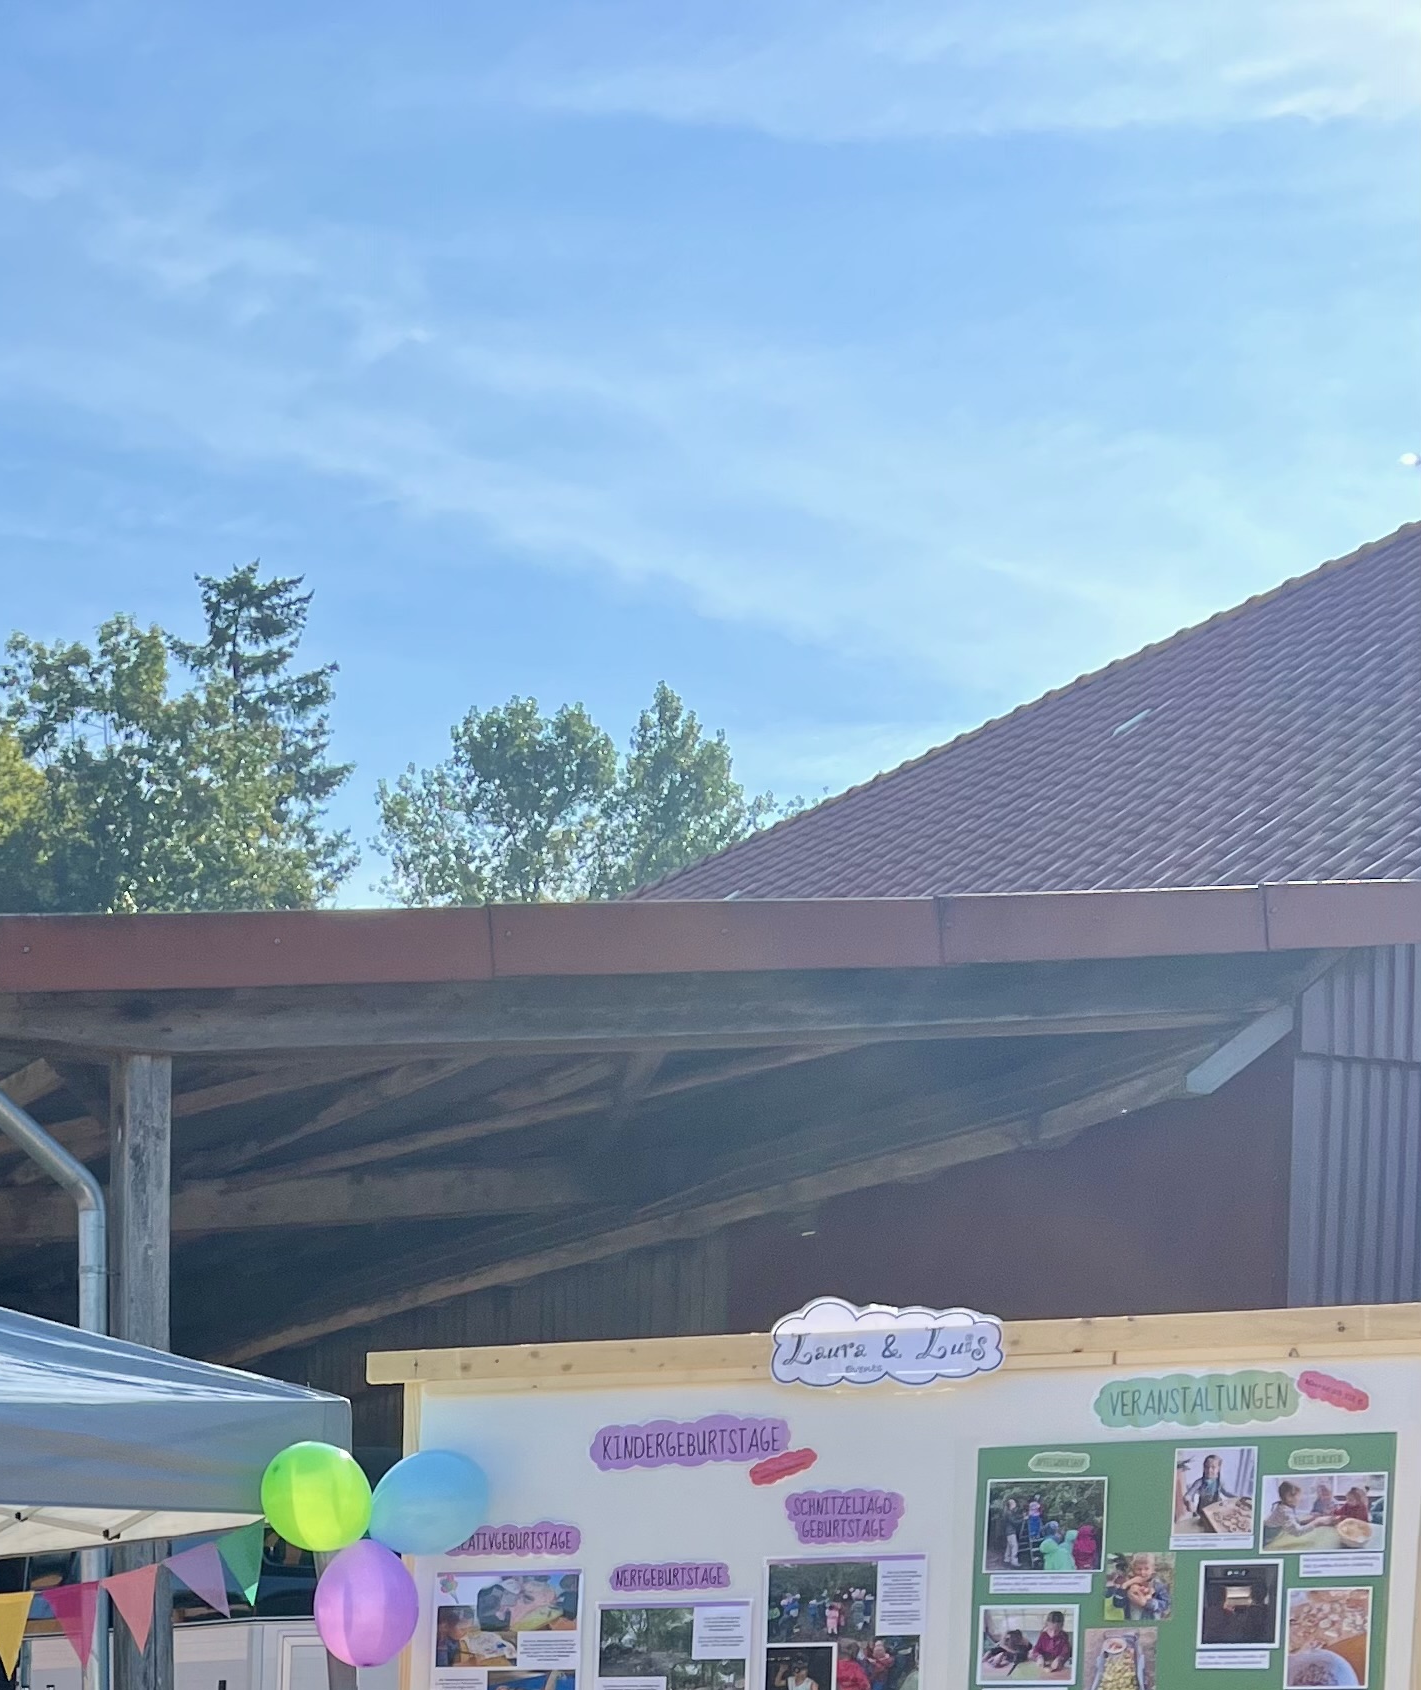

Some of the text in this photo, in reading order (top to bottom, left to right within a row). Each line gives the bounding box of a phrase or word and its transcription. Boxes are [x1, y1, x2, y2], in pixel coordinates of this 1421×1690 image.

[782, 1326, 988, 1366] Laura & Luis
[1109, 1382, 1290, 1417] VERANSTALTUNGEN
[601, 1425, 781, 1461] KINDERGEBURTSTAGE
[792, 1495, 898, 1517] SCHNITZELJAGD-
[801, 1518, 887, 1539] GEBURTSTAGE
[615, 1566, 724, 1588] NERFGEBURTSTAGE
